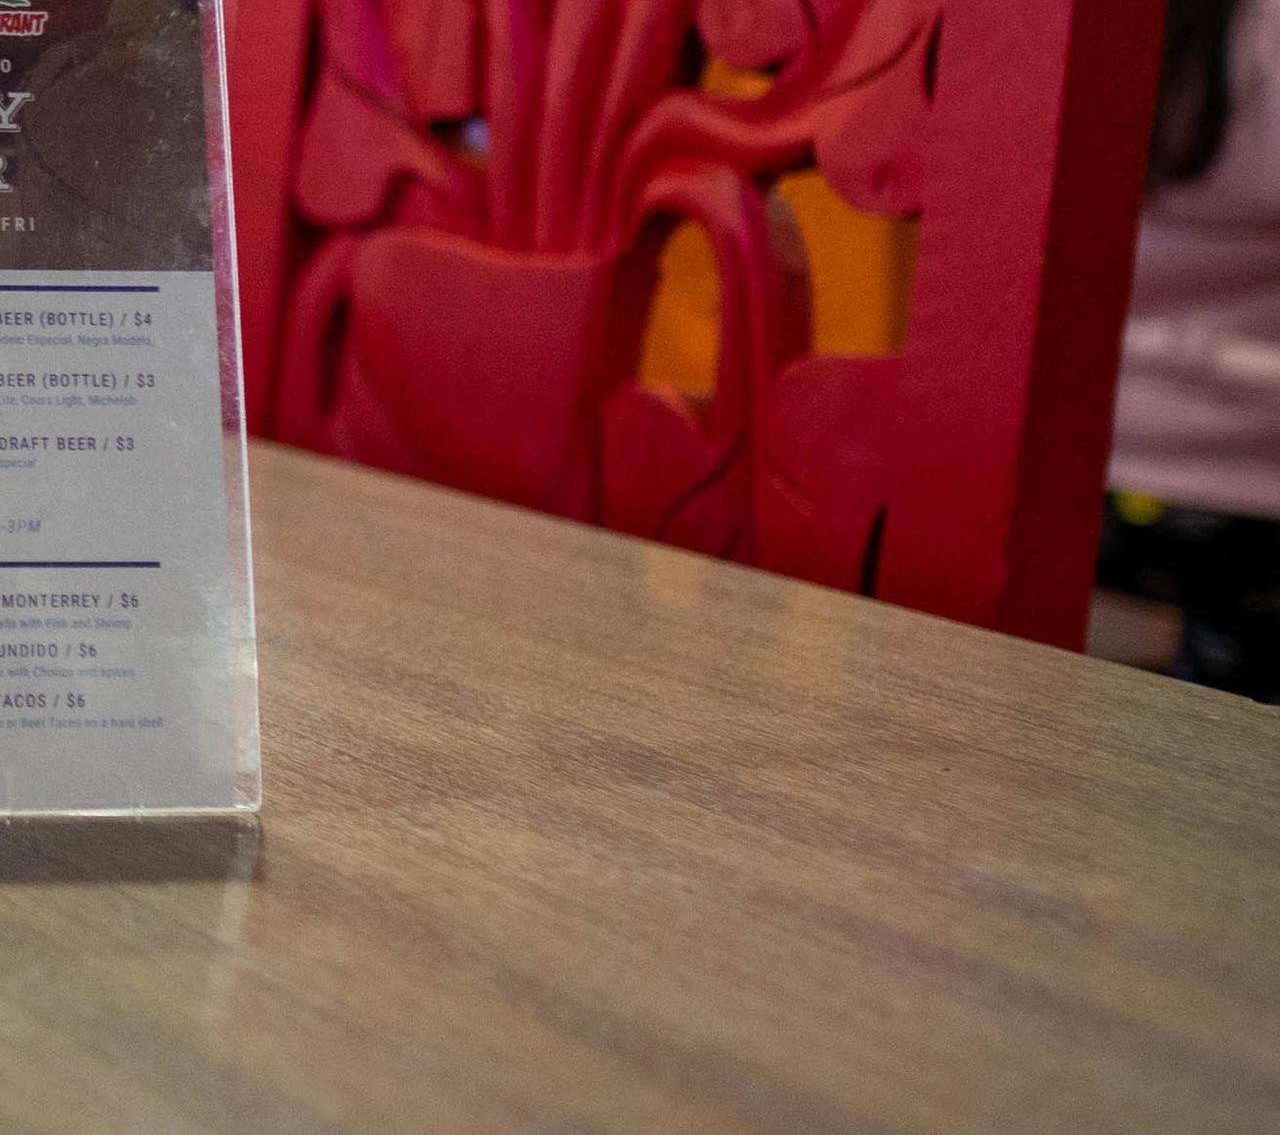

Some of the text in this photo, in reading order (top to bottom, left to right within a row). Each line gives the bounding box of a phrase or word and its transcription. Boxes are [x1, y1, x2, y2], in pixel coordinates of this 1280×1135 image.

[41, 312, 114, 328] (BOTTLE)
[134, 312, 152, 326] $4
[43, 373, 116, 389] (BOTTLE)
[136, 374, 155, 387] $3
[57, 437, 96, 450] BEER
[116, 436, 135, 451] $3
[2, 595, 100, 608] MONTERREY
[121, 593, 139, 609] $6
[79, 643, 97, 658] $6
[67, 693, 85, 708] $6
